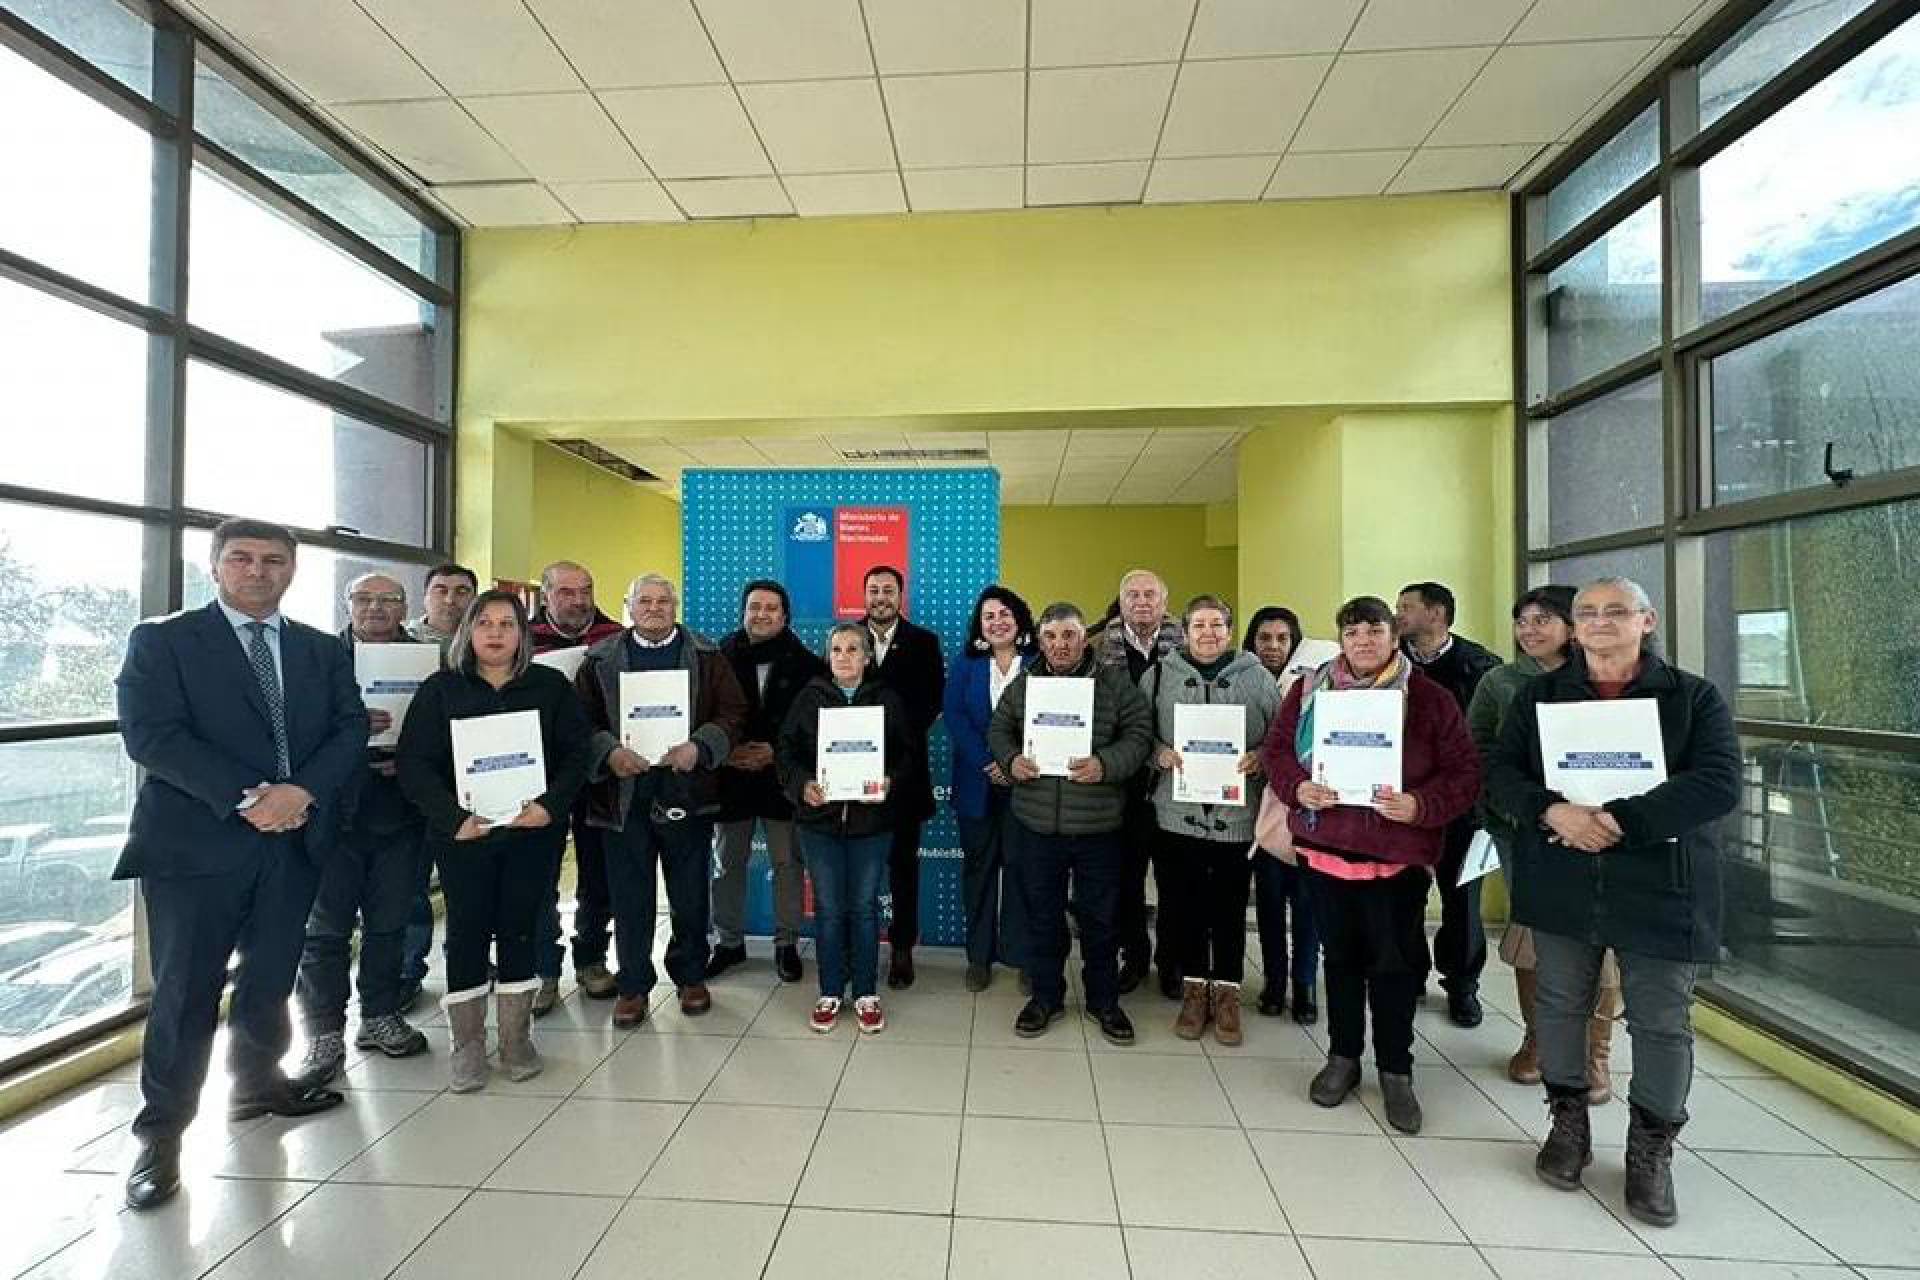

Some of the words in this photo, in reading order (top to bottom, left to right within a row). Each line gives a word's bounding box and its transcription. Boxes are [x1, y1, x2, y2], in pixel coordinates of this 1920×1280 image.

[839, 511, 887, 522] Ministerio
[888, 512, 900, 521] de
[839, 523, 870, 532] Bienes
[839, 534, 889, 543] Nacionales
